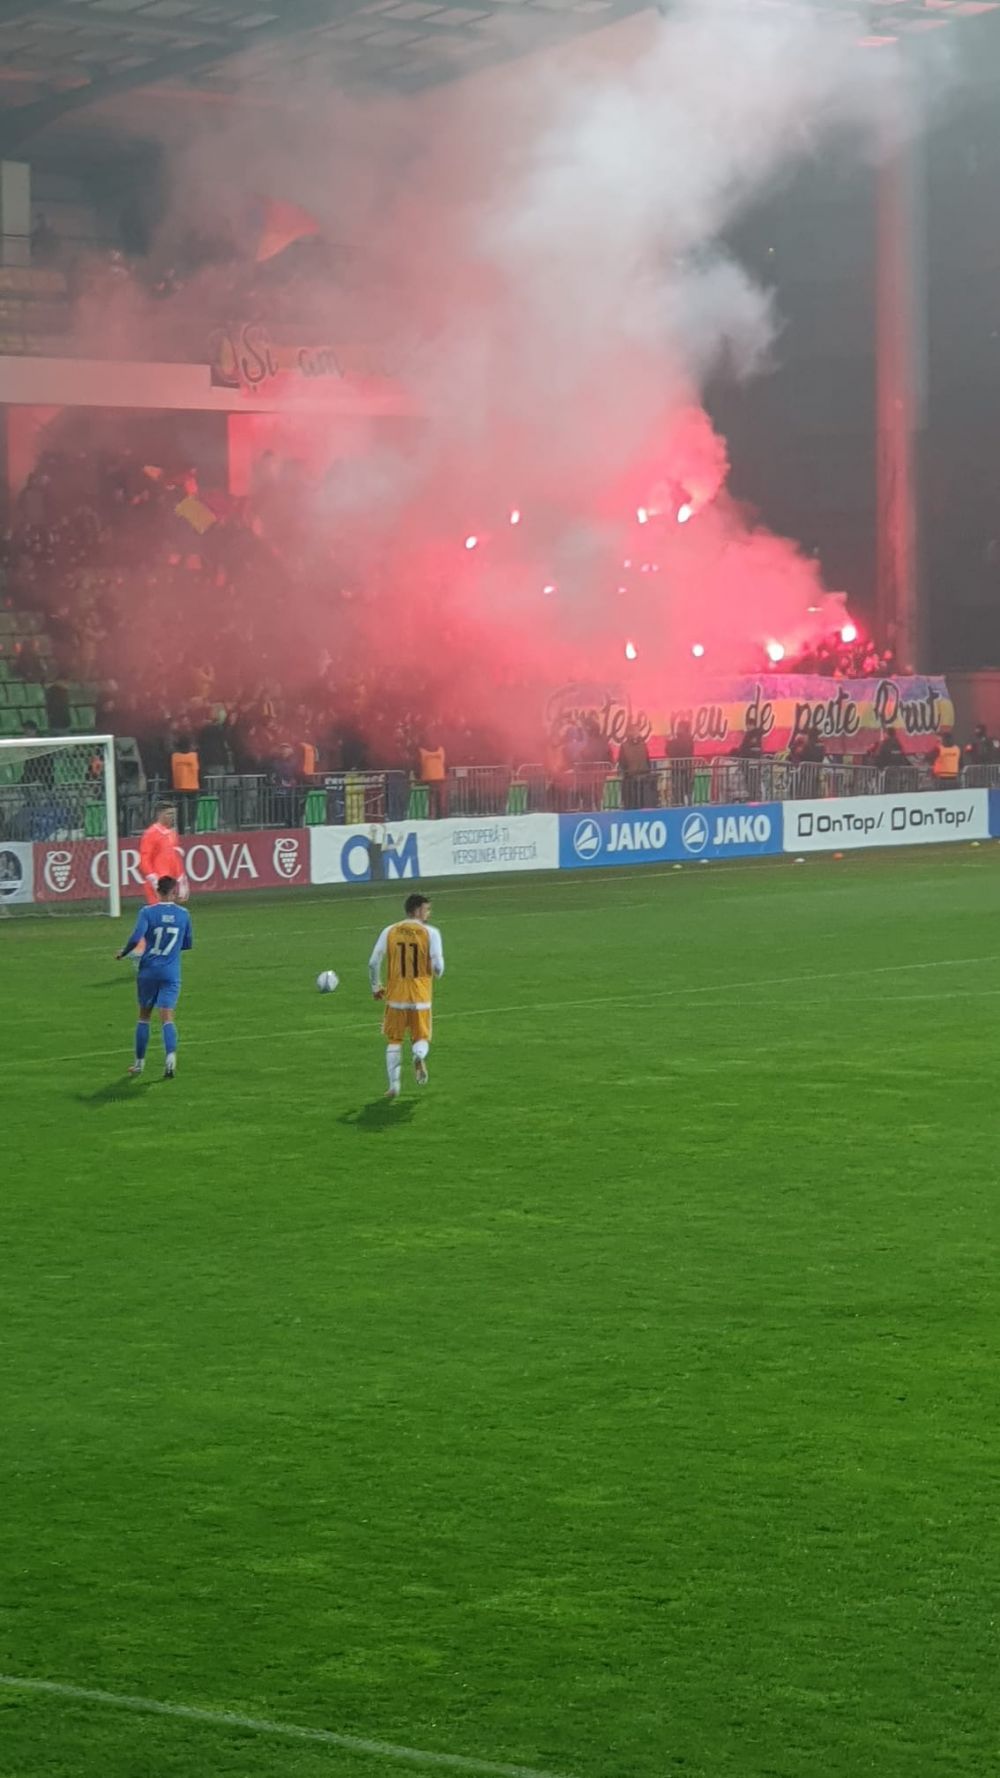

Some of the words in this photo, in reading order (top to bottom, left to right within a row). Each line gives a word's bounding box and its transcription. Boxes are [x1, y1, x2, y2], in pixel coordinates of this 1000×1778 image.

[745, 682, 775, 736] de
[789, 686, 861, 751] peste
[875, 680, 943, 739] Prut
[607, 820, 667, 852] JAKO
[713, 814, 772, 845] JAKO
[92, 843, 259, 887] CROVA
[151, 926, 180, 956] 17
[396, 942, 419, 978] 11
